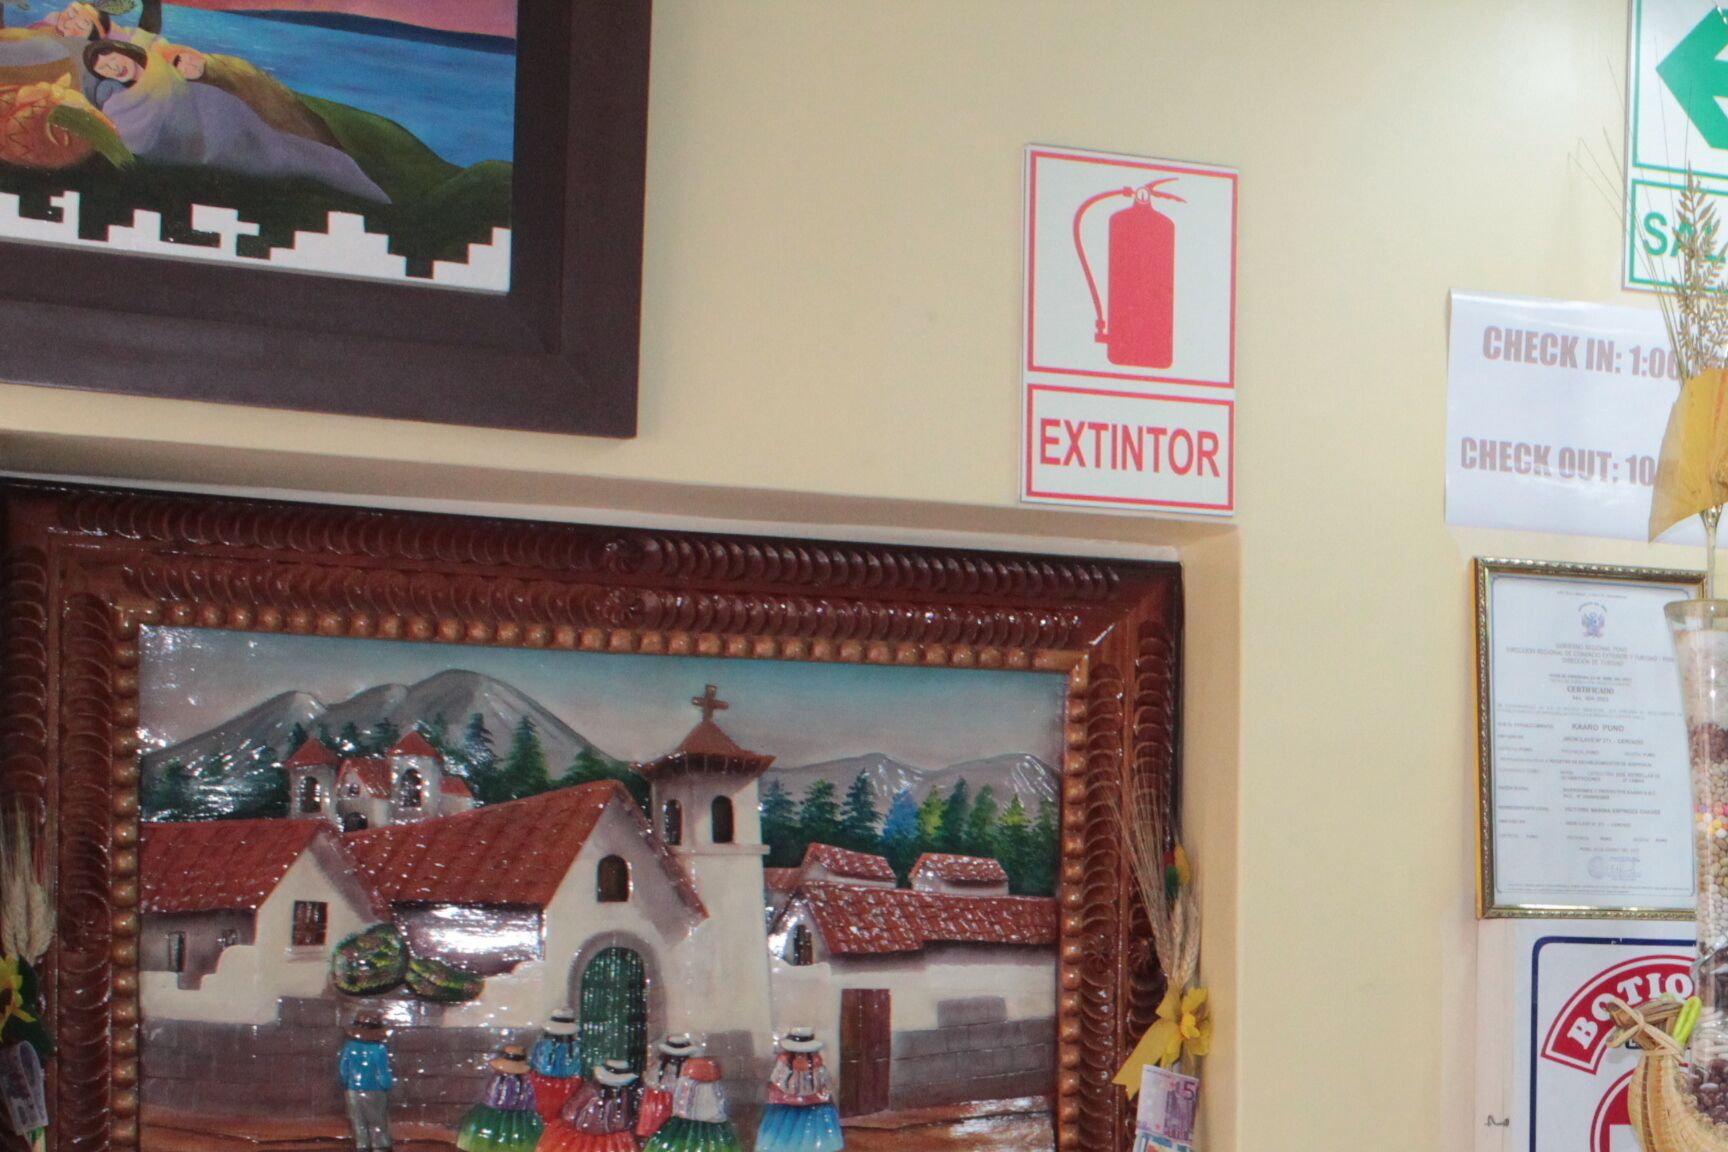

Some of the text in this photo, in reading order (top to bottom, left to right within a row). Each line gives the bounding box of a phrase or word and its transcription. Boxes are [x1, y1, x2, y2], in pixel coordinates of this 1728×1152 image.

[1482, 325, 1579, 369] CHECK
[1585, 338, 1622, 374] IN:
[1040, 418, 1220, 477] EXTINTOR
[1461, 437, 1551, 477] CHECK
[1558, 447, 1619, 483] OUT:
